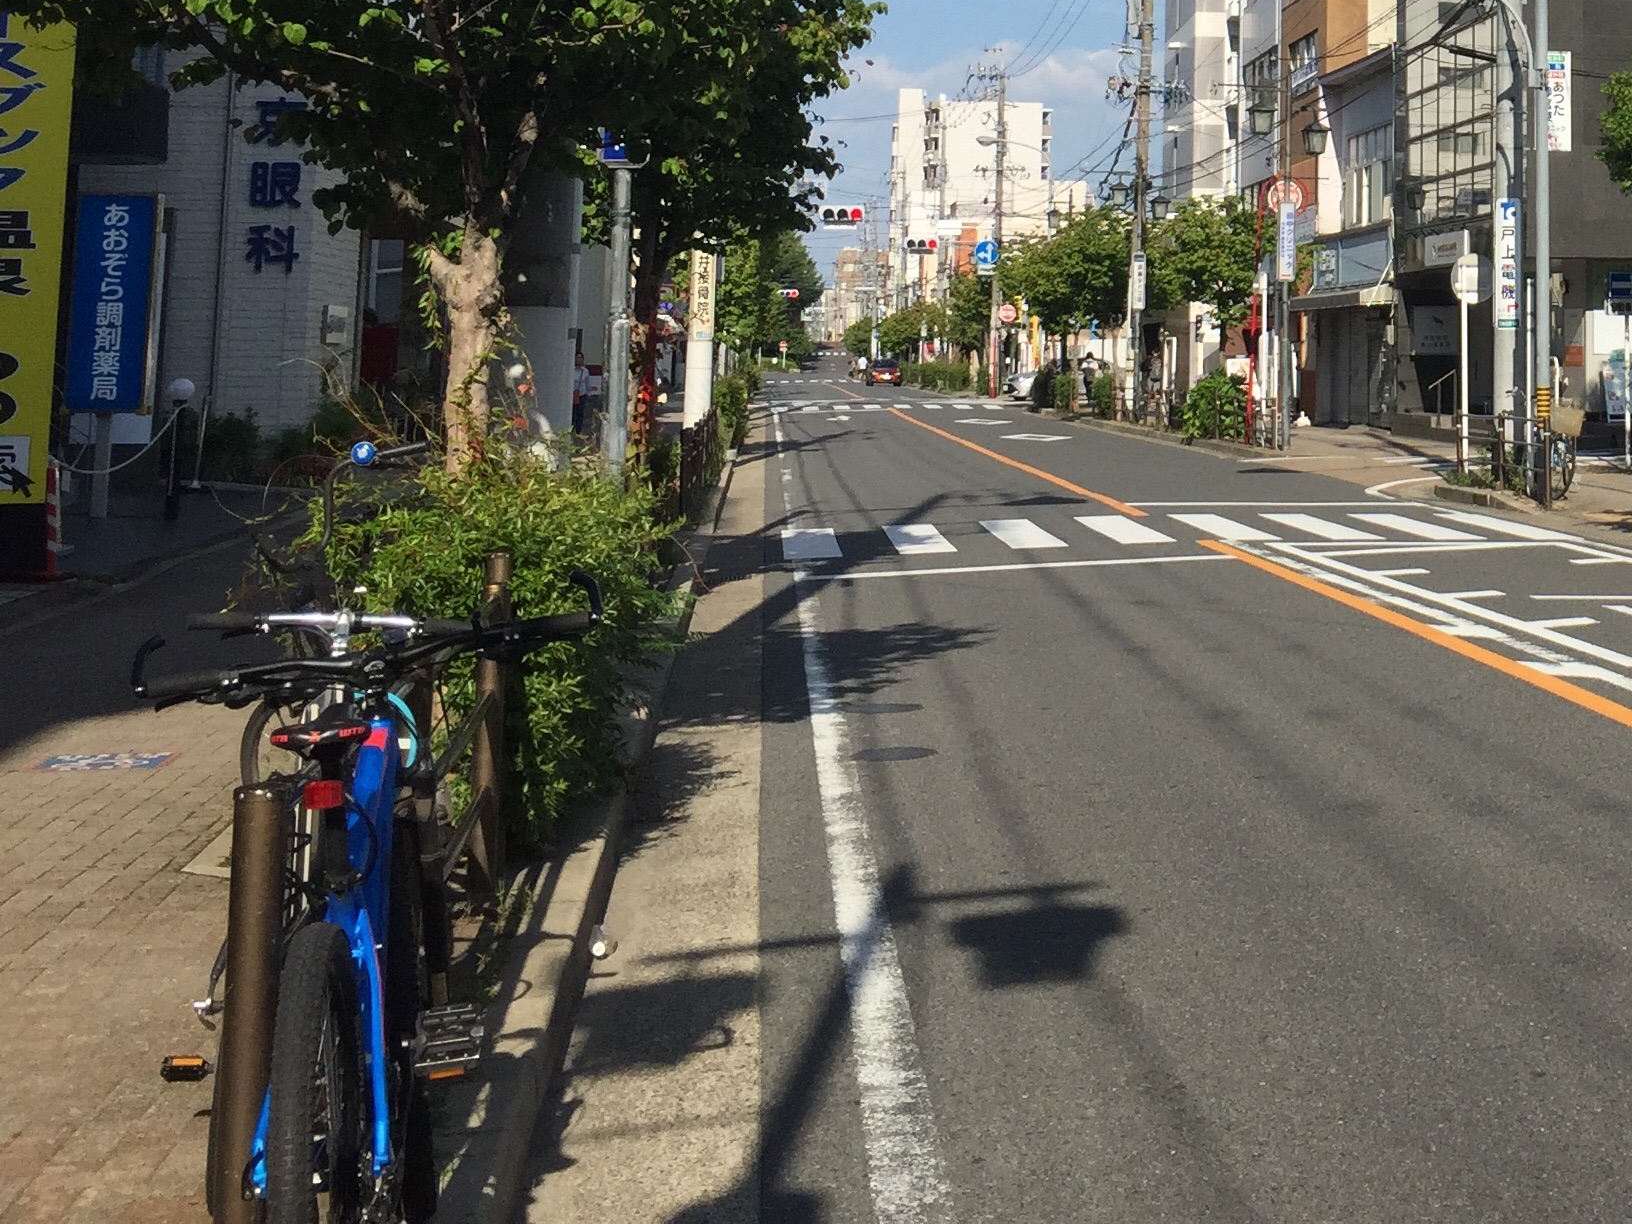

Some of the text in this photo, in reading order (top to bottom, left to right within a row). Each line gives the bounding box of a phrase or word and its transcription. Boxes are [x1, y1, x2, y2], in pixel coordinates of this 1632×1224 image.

[89, 203, 130, 402] あおぞら調剤薬局
